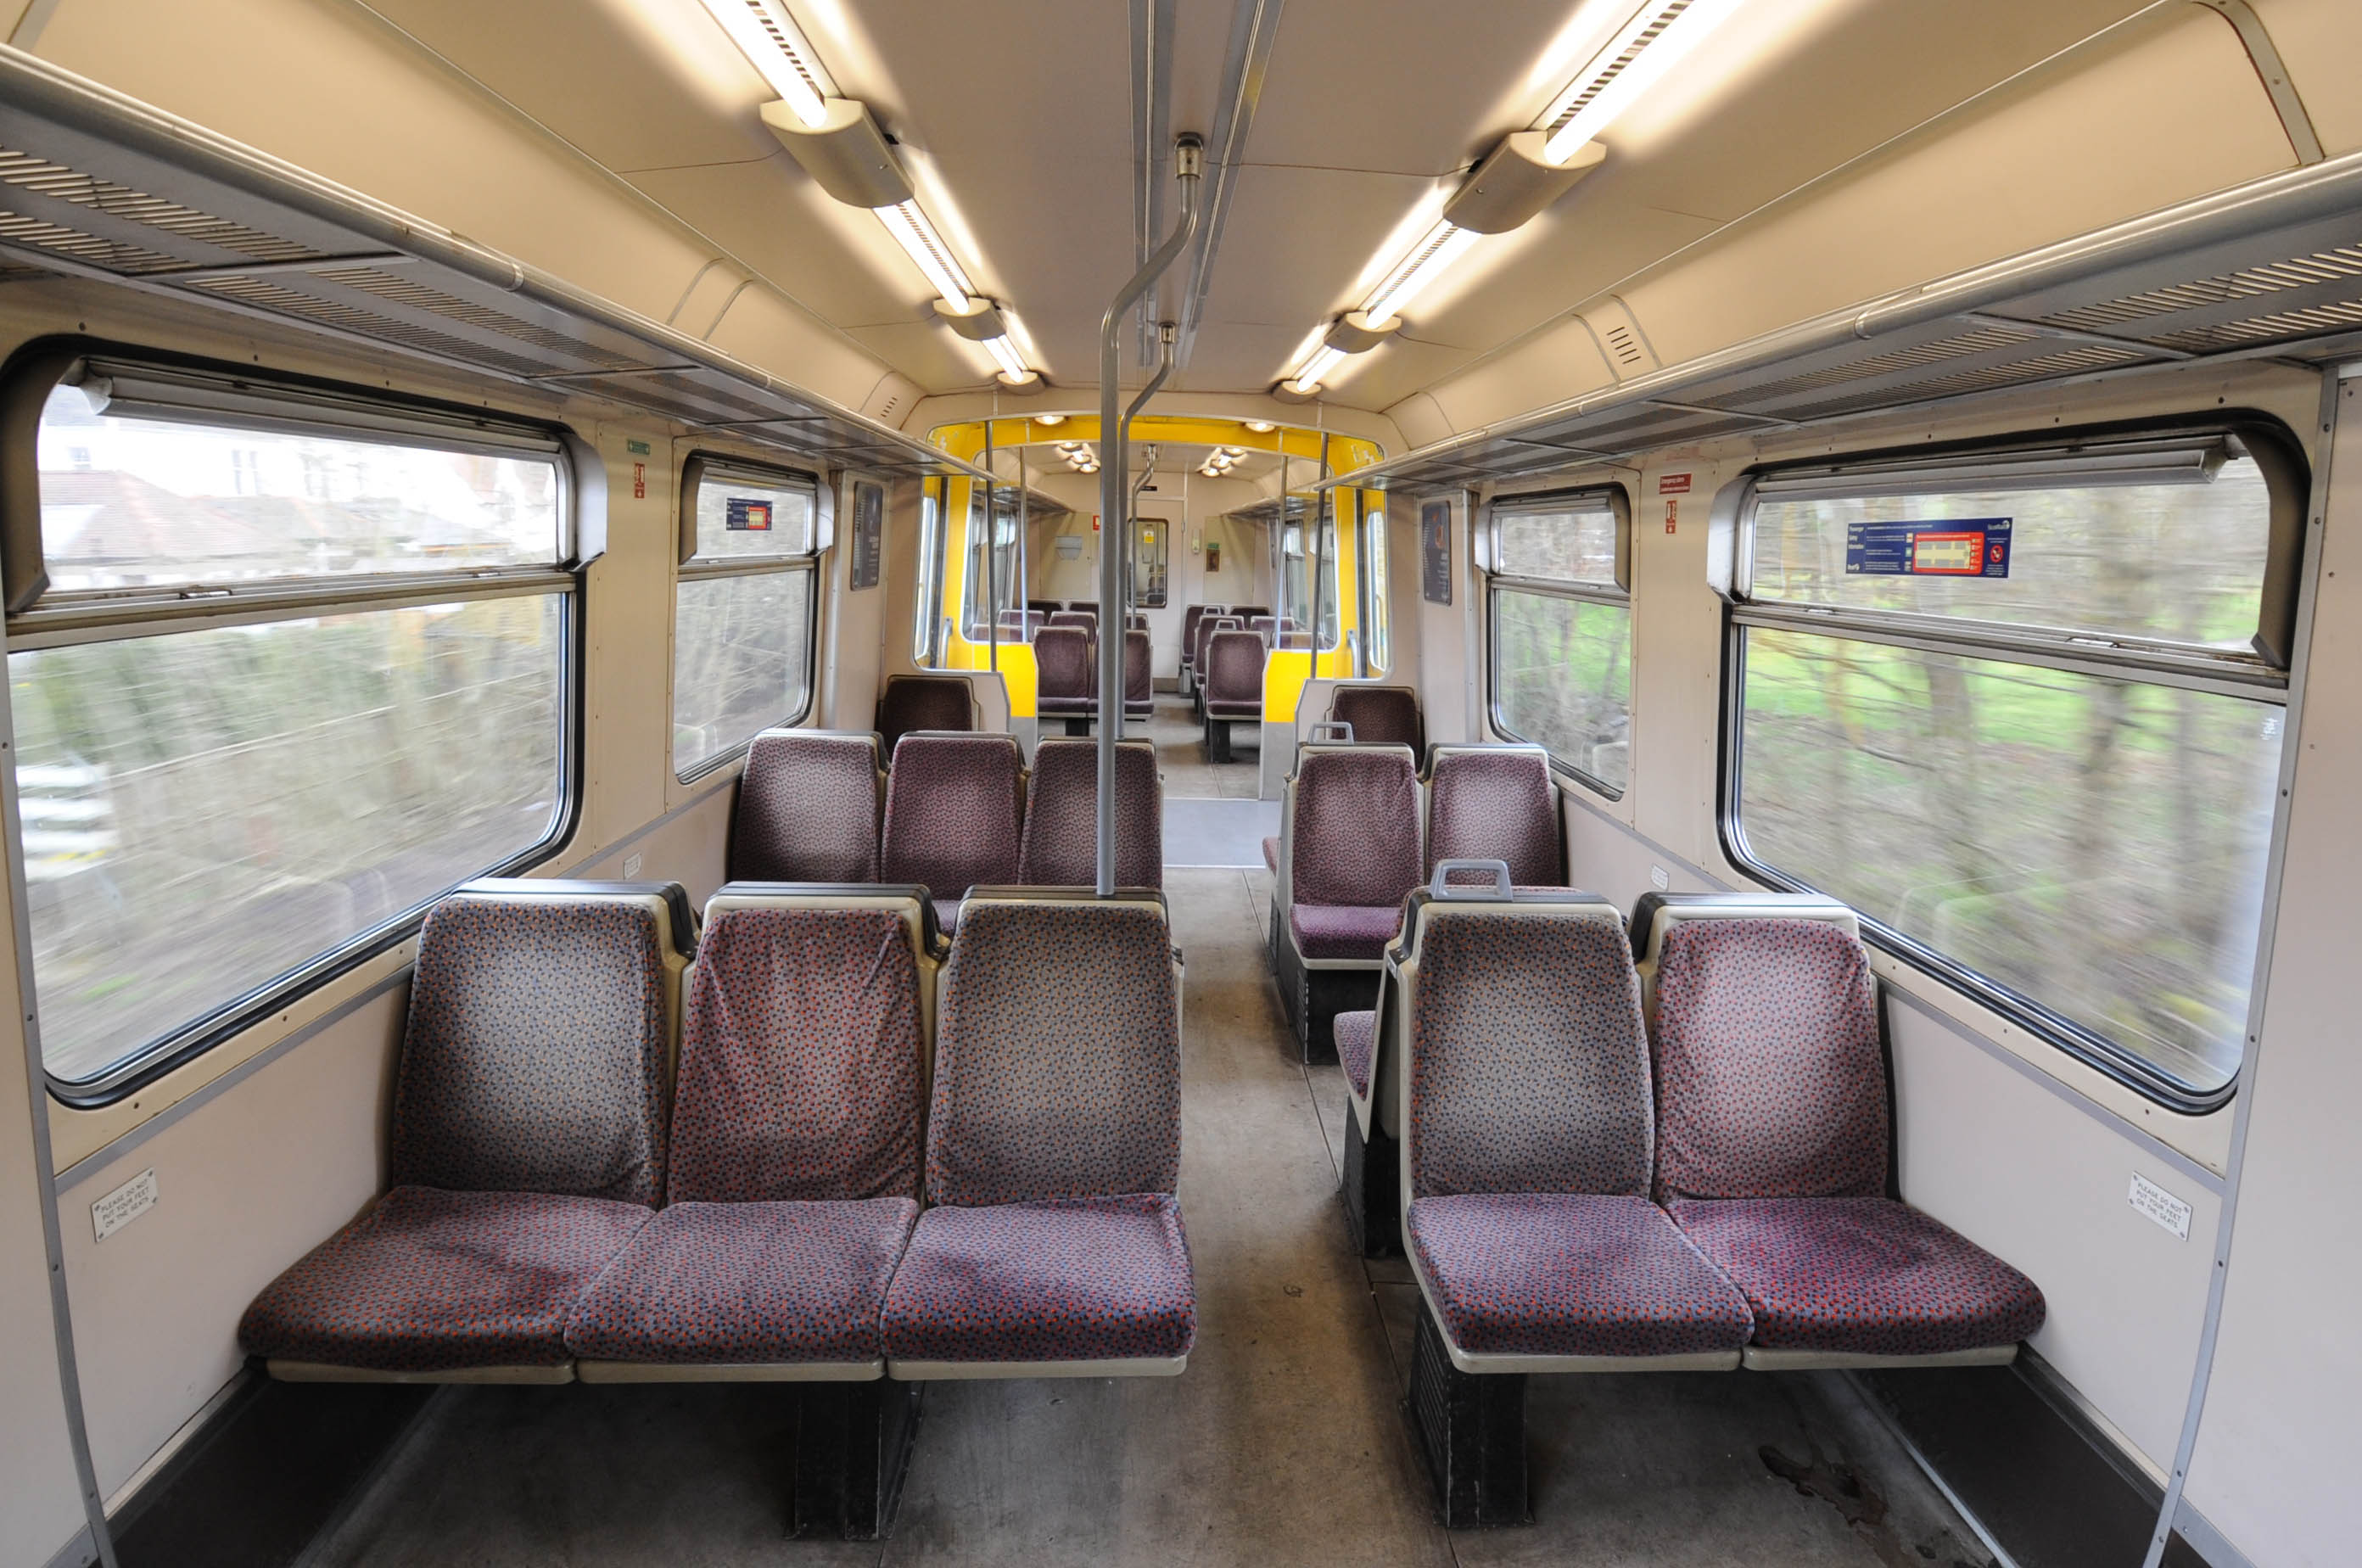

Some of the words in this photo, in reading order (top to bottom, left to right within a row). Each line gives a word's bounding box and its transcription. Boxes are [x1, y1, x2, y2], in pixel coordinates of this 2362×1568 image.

[101, 1195, 124, 1212] PLEASE
[126, 1188, 135, 1196] DO
[136, 1179, 148, 1188] NOT
[103, 1208, 115, 1221] PUT
[116, 1197, 133, 1211] YOUR
[135, 1186, 149, 1200] FEET
[2136, 1190, 2147, 1200] PUT
[2149, 1198, 2164, 1210] YOUR
[2166, 1208, 2181, 1222] FEET
[2137, 1183, 2158, 1199] PLEASE
[2159, 1196, 2169, 1206] DO
[2170, 1203, 2182, 1214] NOT
[105, 1219, 115, 1229] ON
[116, 1210, 128, 1220] THE
[131, 1197, 149, 1211] SEATS
[2136, 1198, 2145, 1207] ON
[2147, 1204, 2158, 1215] THE
[2159, 1212, 2178, 1228] SEATS
